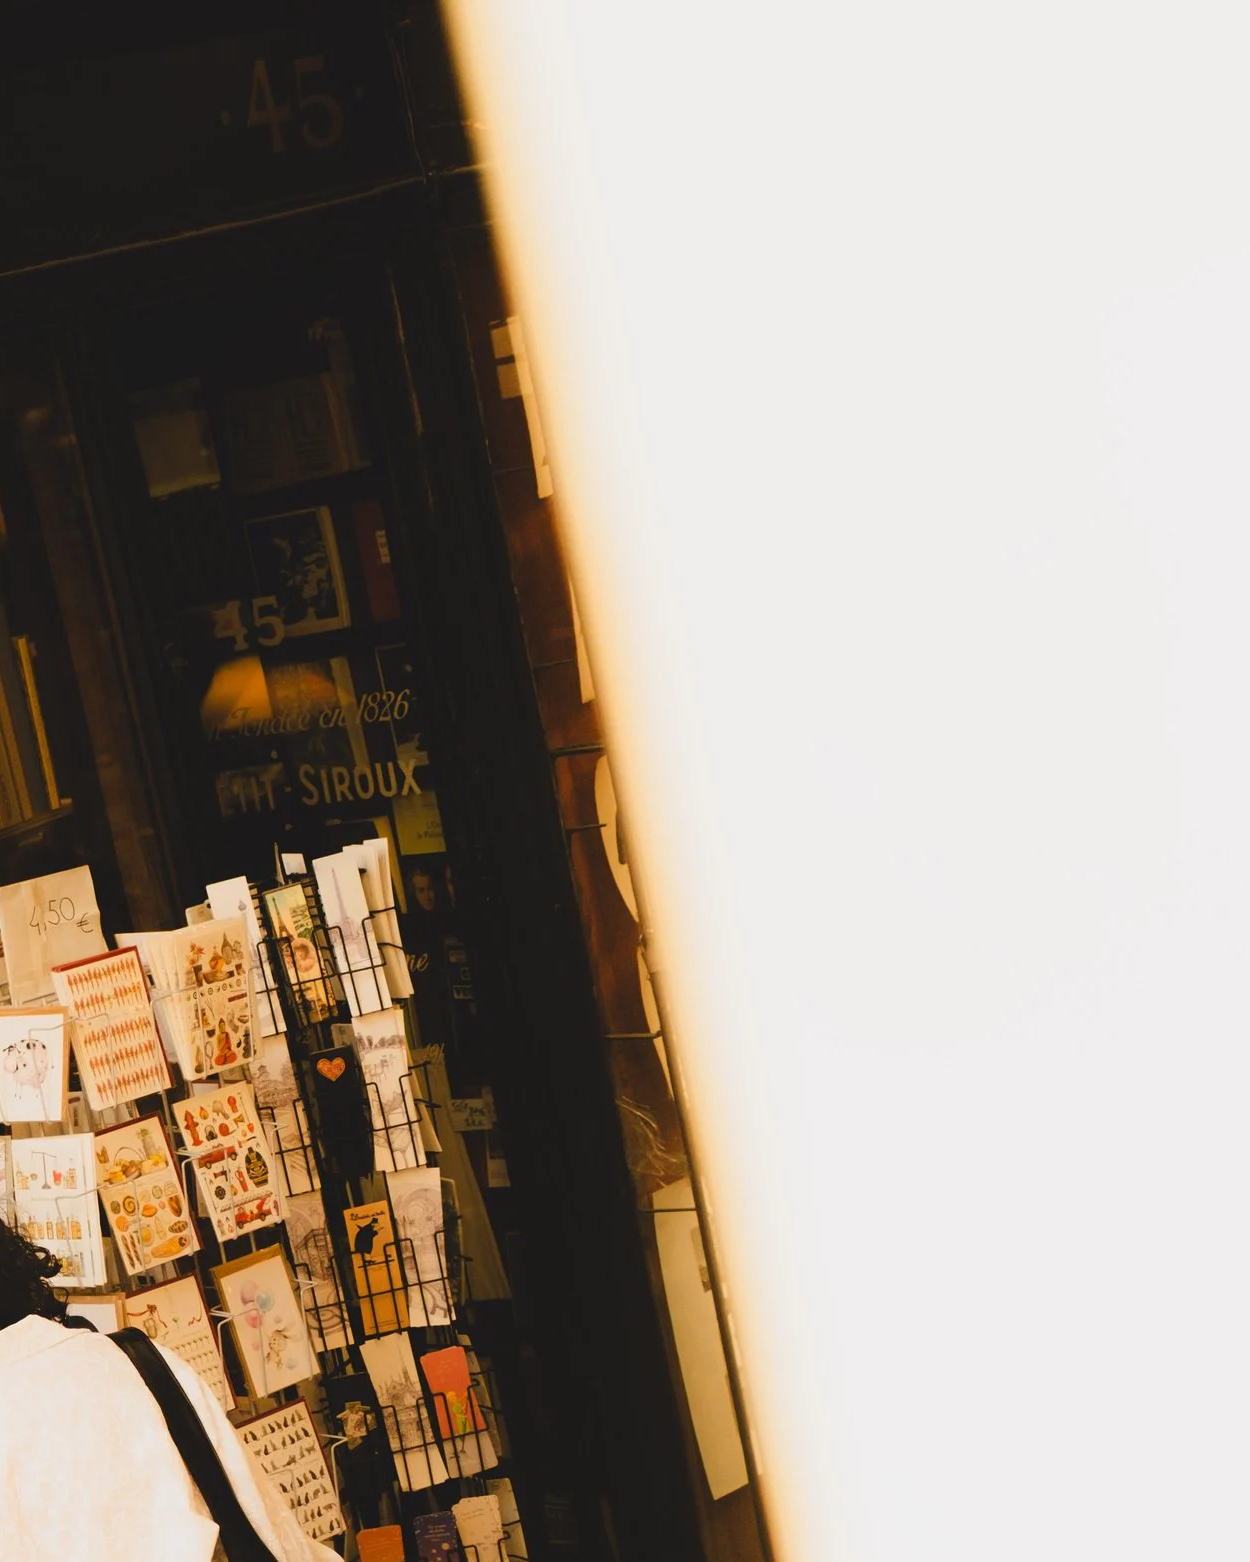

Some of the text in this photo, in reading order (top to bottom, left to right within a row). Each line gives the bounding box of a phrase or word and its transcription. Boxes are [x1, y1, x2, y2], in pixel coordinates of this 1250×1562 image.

[246, 51, 345, 153] 45
[212, 595, 286, 651] 45
[356, 689, 411, 723] 1826
[30, 897, 76, 937] 4,50
